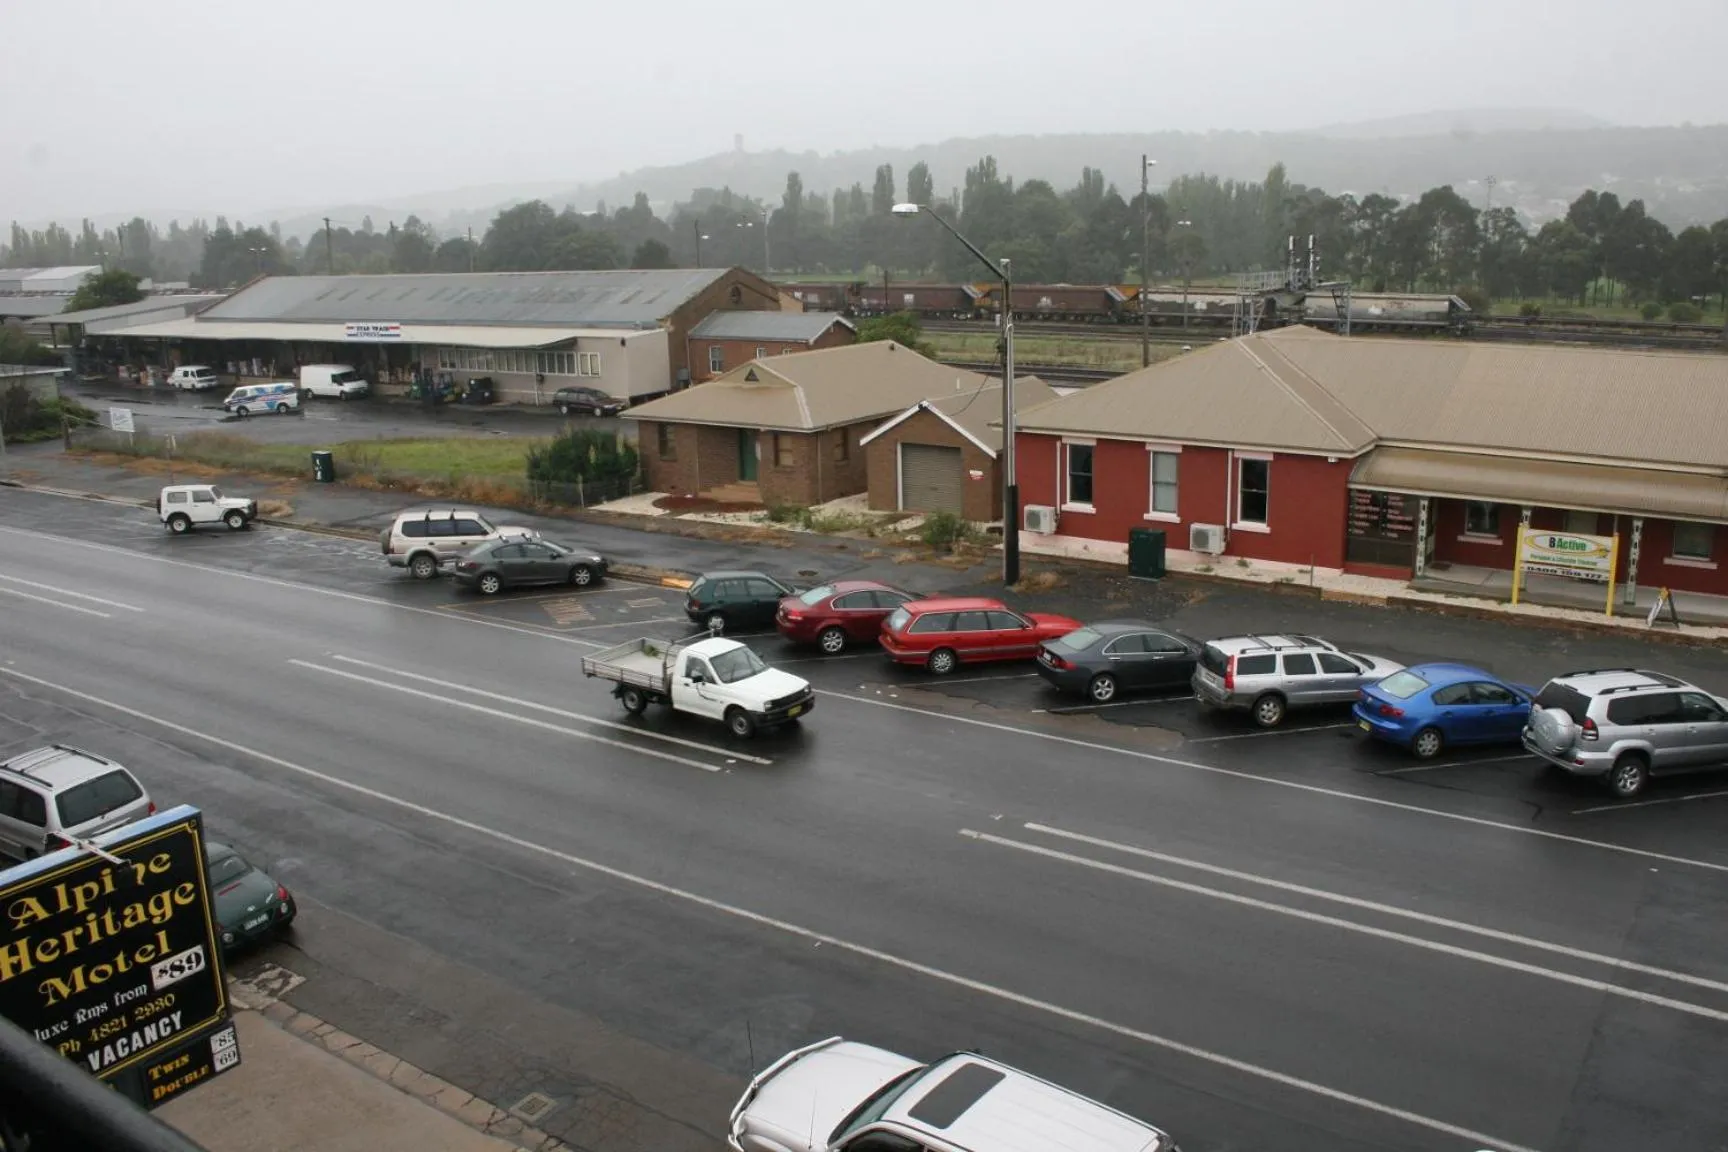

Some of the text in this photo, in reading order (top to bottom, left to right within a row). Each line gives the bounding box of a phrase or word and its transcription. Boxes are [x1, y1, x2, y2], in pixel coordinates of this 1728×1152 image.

[1556, 538, 1587, 551] Active
[0, 882, 196, 983] Heritage
[38, 930, 172, 1007] Motel
[74, 1001, 109, 1025] Rms
[114, 984, 148, 1006] from
[157, 951, 203, 979] $89
[88, 1010, 182, 1072] VACANCY
[90, 1015, 127, 1041] 4821
